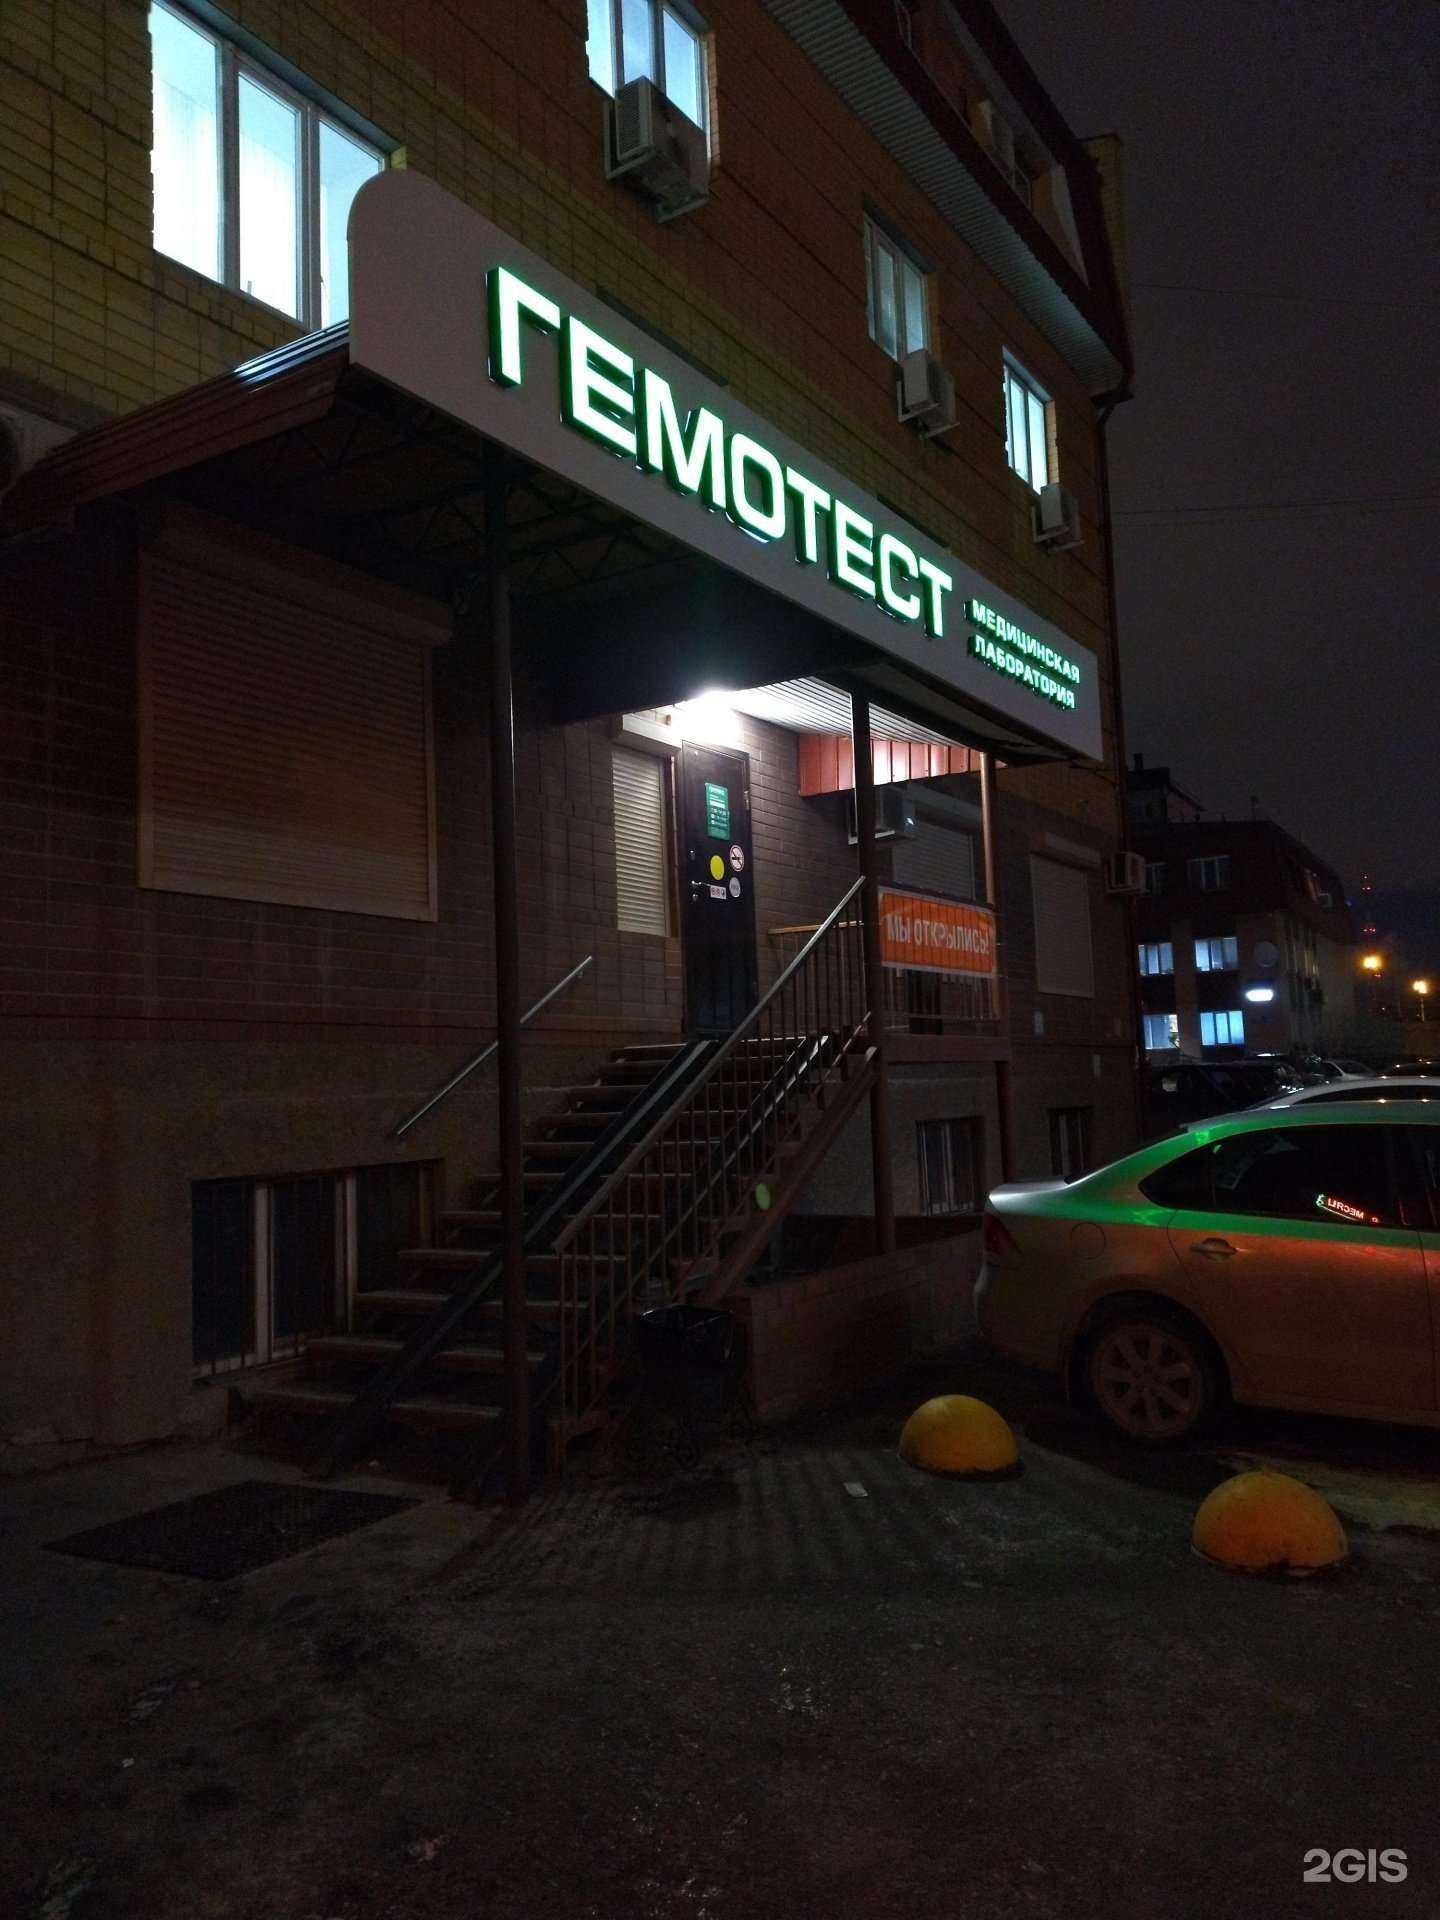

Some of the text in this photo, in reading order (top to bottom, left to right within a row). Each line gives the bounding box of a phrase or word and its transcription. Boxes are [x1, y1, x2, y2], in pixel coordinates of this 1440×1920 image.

[488, 266, 953, 639] ГЕМОТЕСТ
[970, 599, 1081, 684] МЕДИЦИНСКАЯ
[974, 634, 1076, 709] ЛАБОРАТОРИЯ
[886, 913, 990, 954] МЫ ОТКРЫЛИСЬ!
